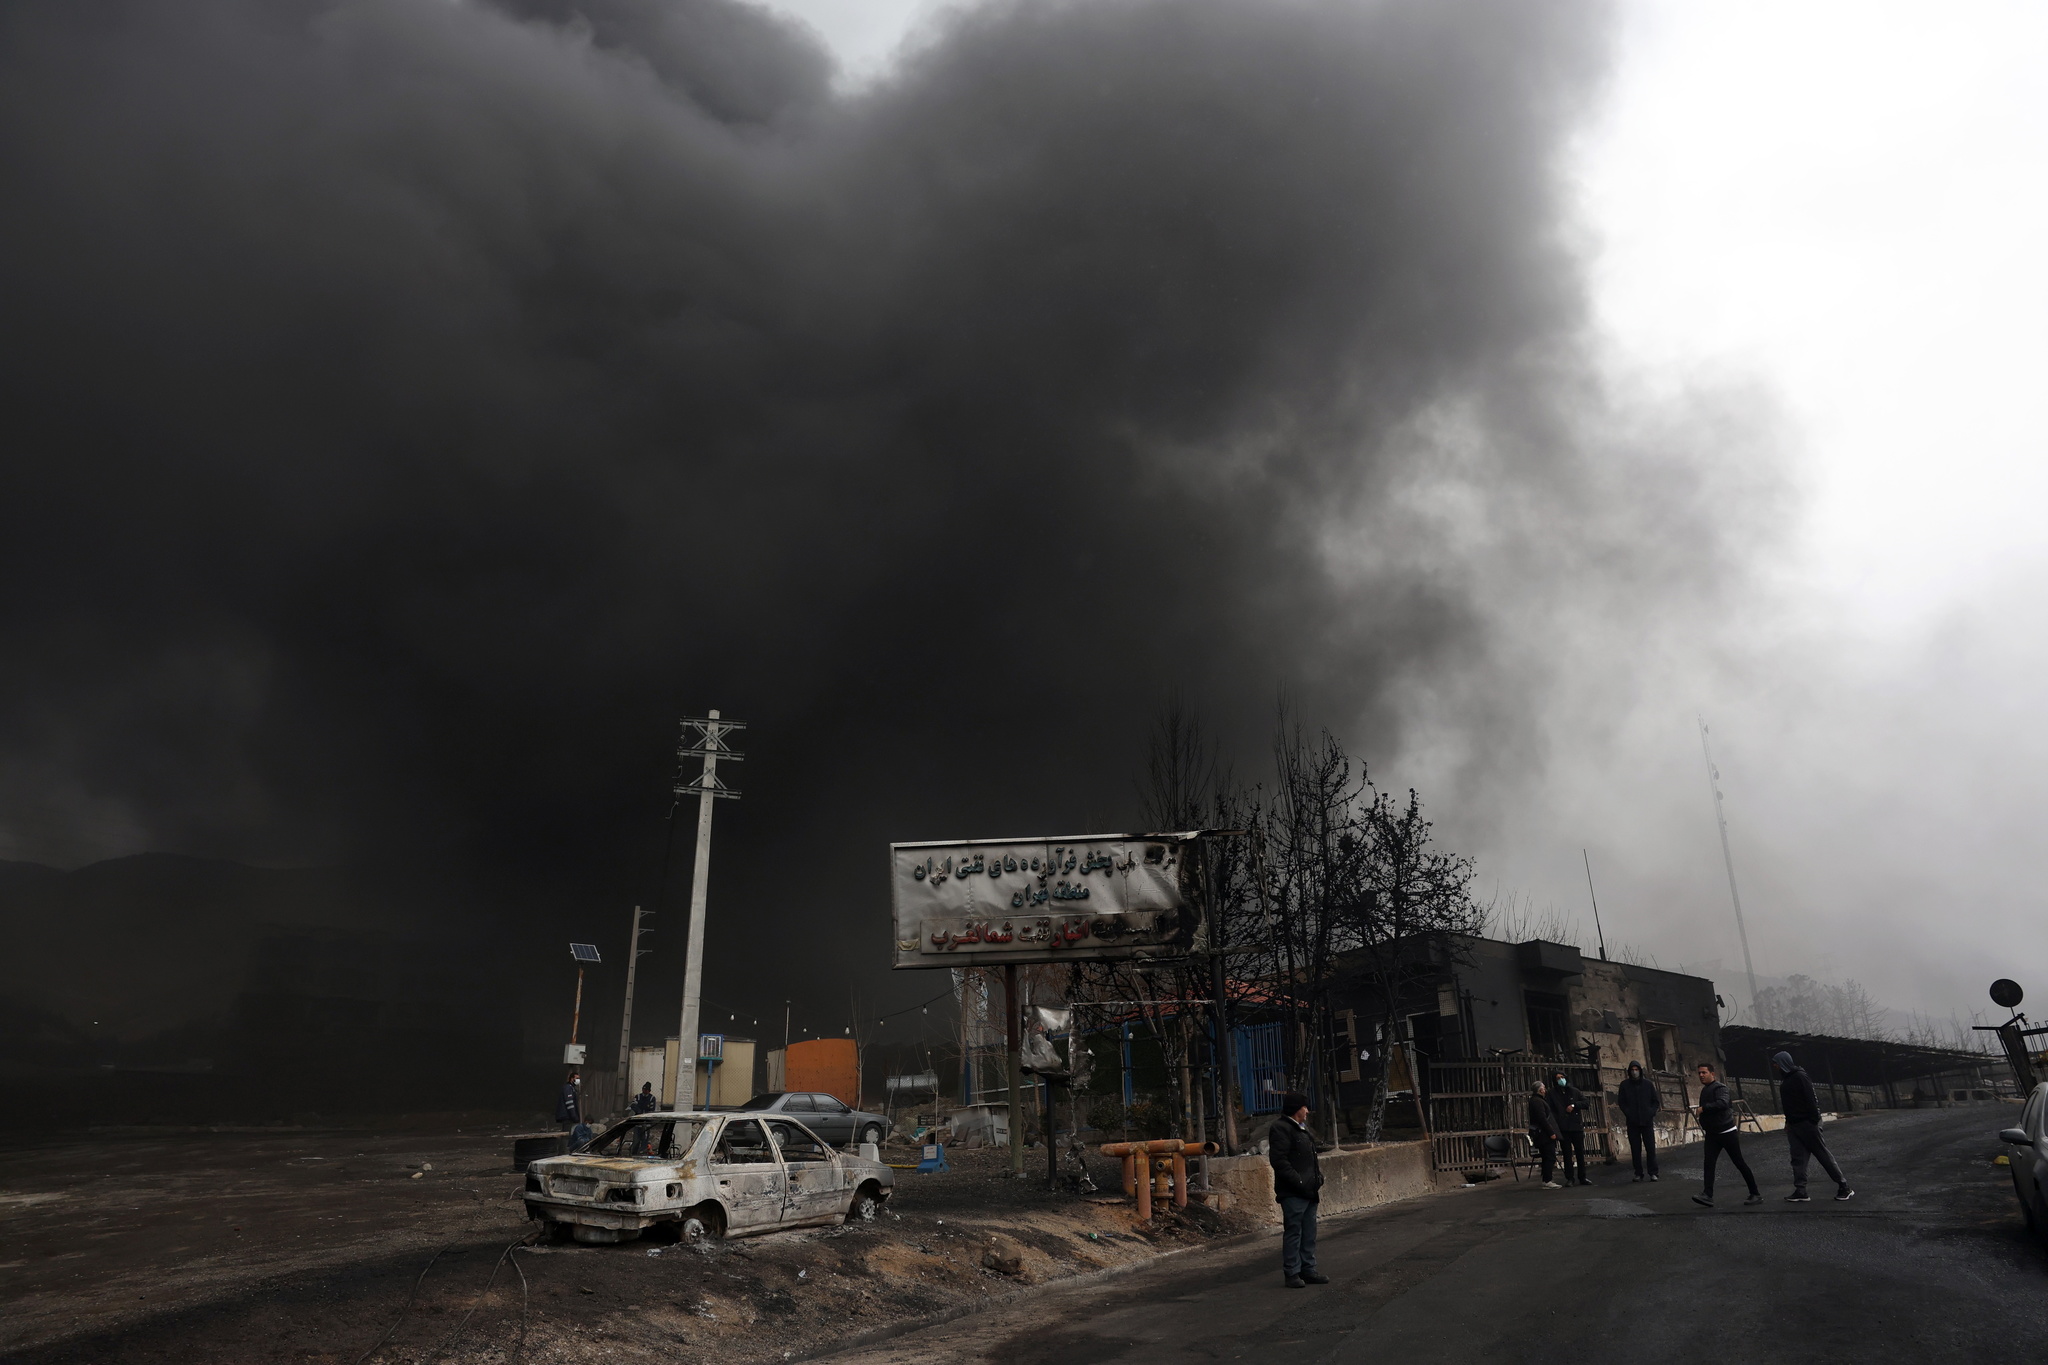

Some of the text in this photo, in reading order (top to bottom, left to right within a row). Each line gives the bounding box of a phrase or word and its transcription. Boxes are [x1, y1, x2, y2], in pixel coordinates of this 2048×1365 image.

[914, 856, 952, 886] ایران
[956, 854, 985, 880] نفتی
[1080, 849, 1113, 877] پخش
[1012, 880, 1090, 907] منطقه تهران
[1018, 919, 1051, 943] نفت
[1050, 918, 1090, 948] انبار
